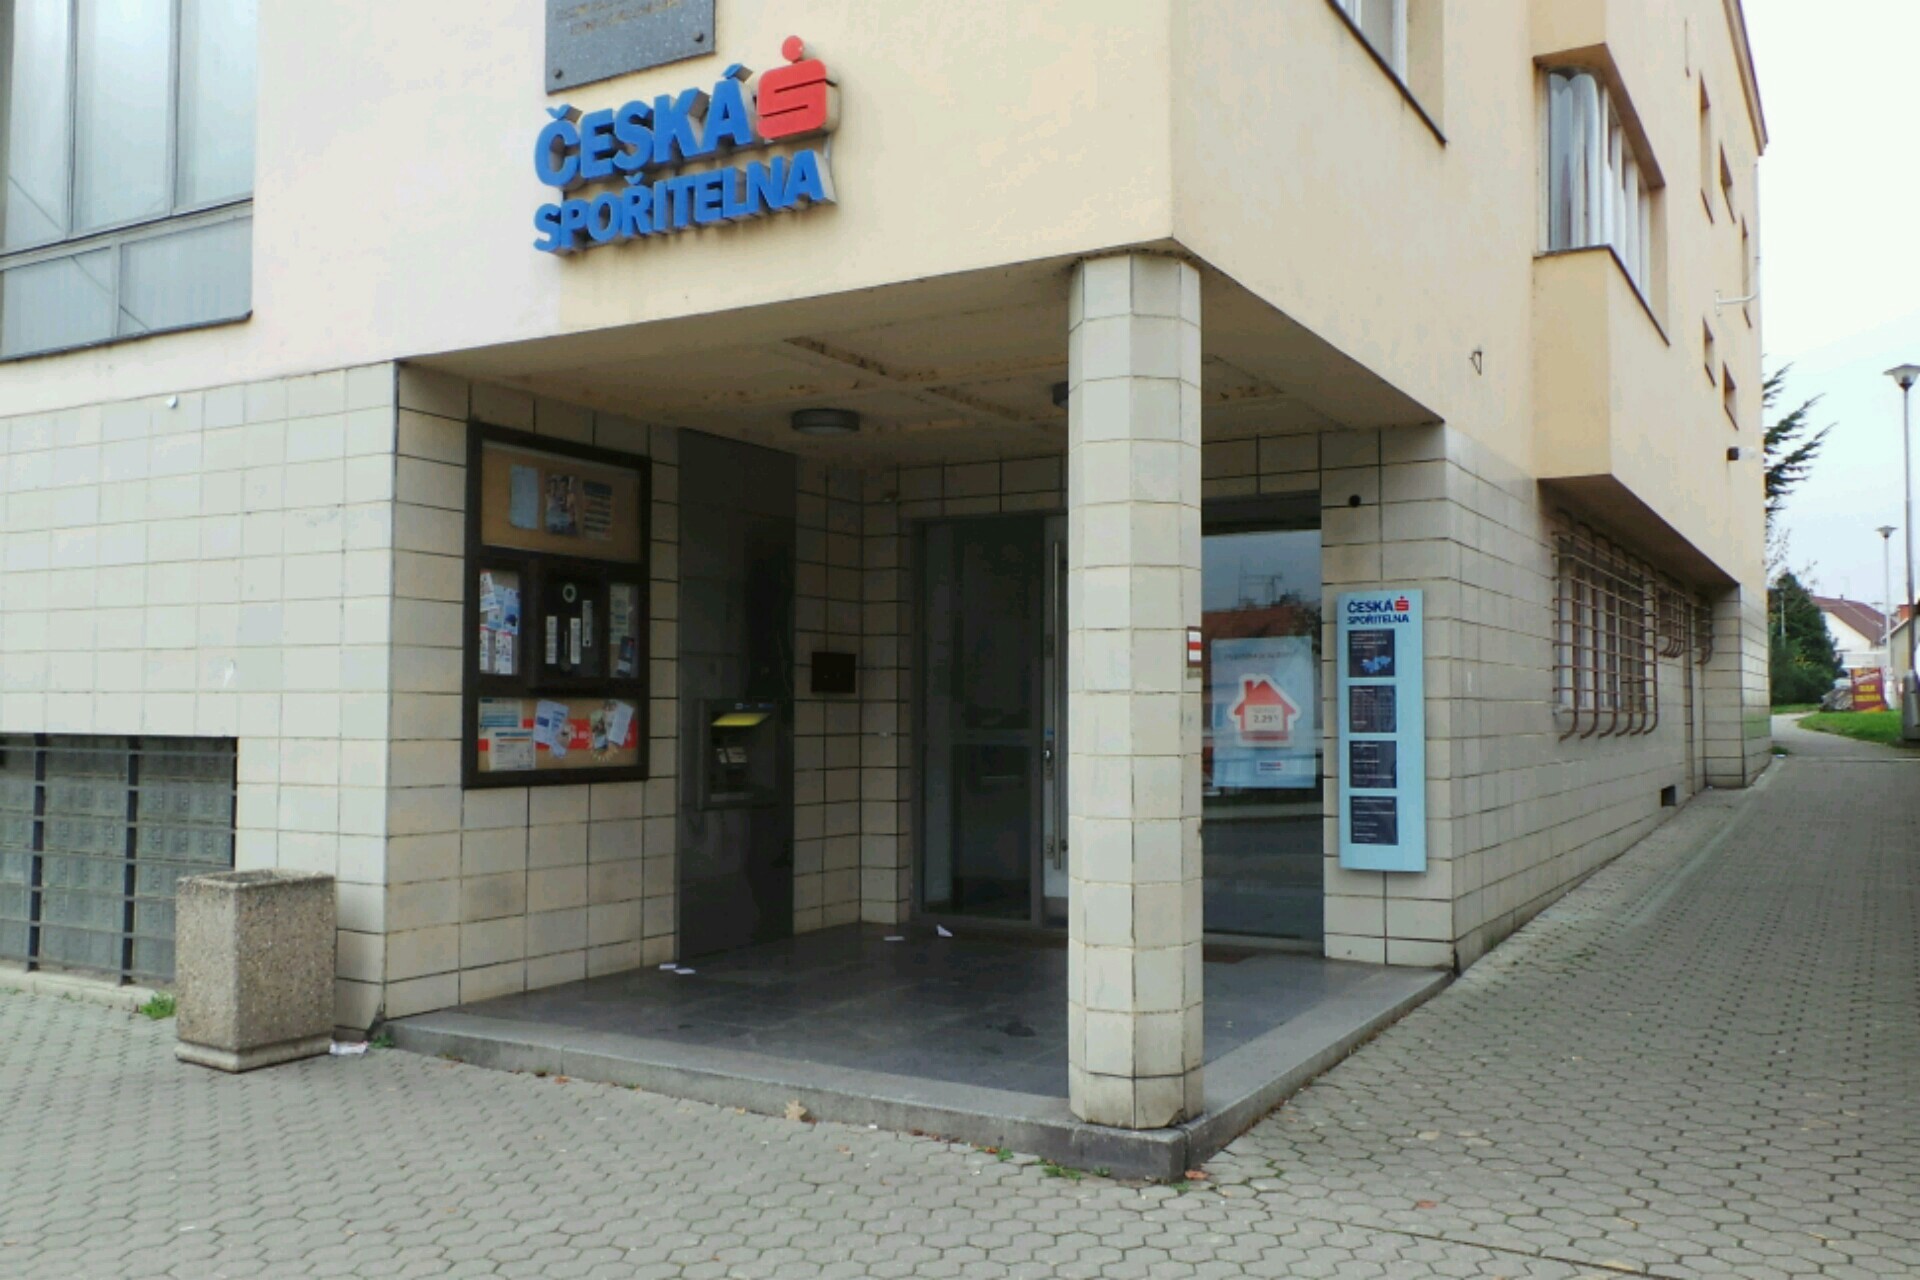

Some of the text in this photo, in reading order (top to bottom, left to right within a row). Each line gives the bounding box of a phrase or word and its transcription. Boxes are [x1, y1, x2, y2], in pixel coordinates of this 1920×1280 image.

[534, 63, 753, 187] ČESKÁ
[533, 150, 825, 252] SPOŘITELNA
[1347, 598, 1394, 613] ČESKÁ
[1347, 614, 1409, 625] SPOŘITELNA
